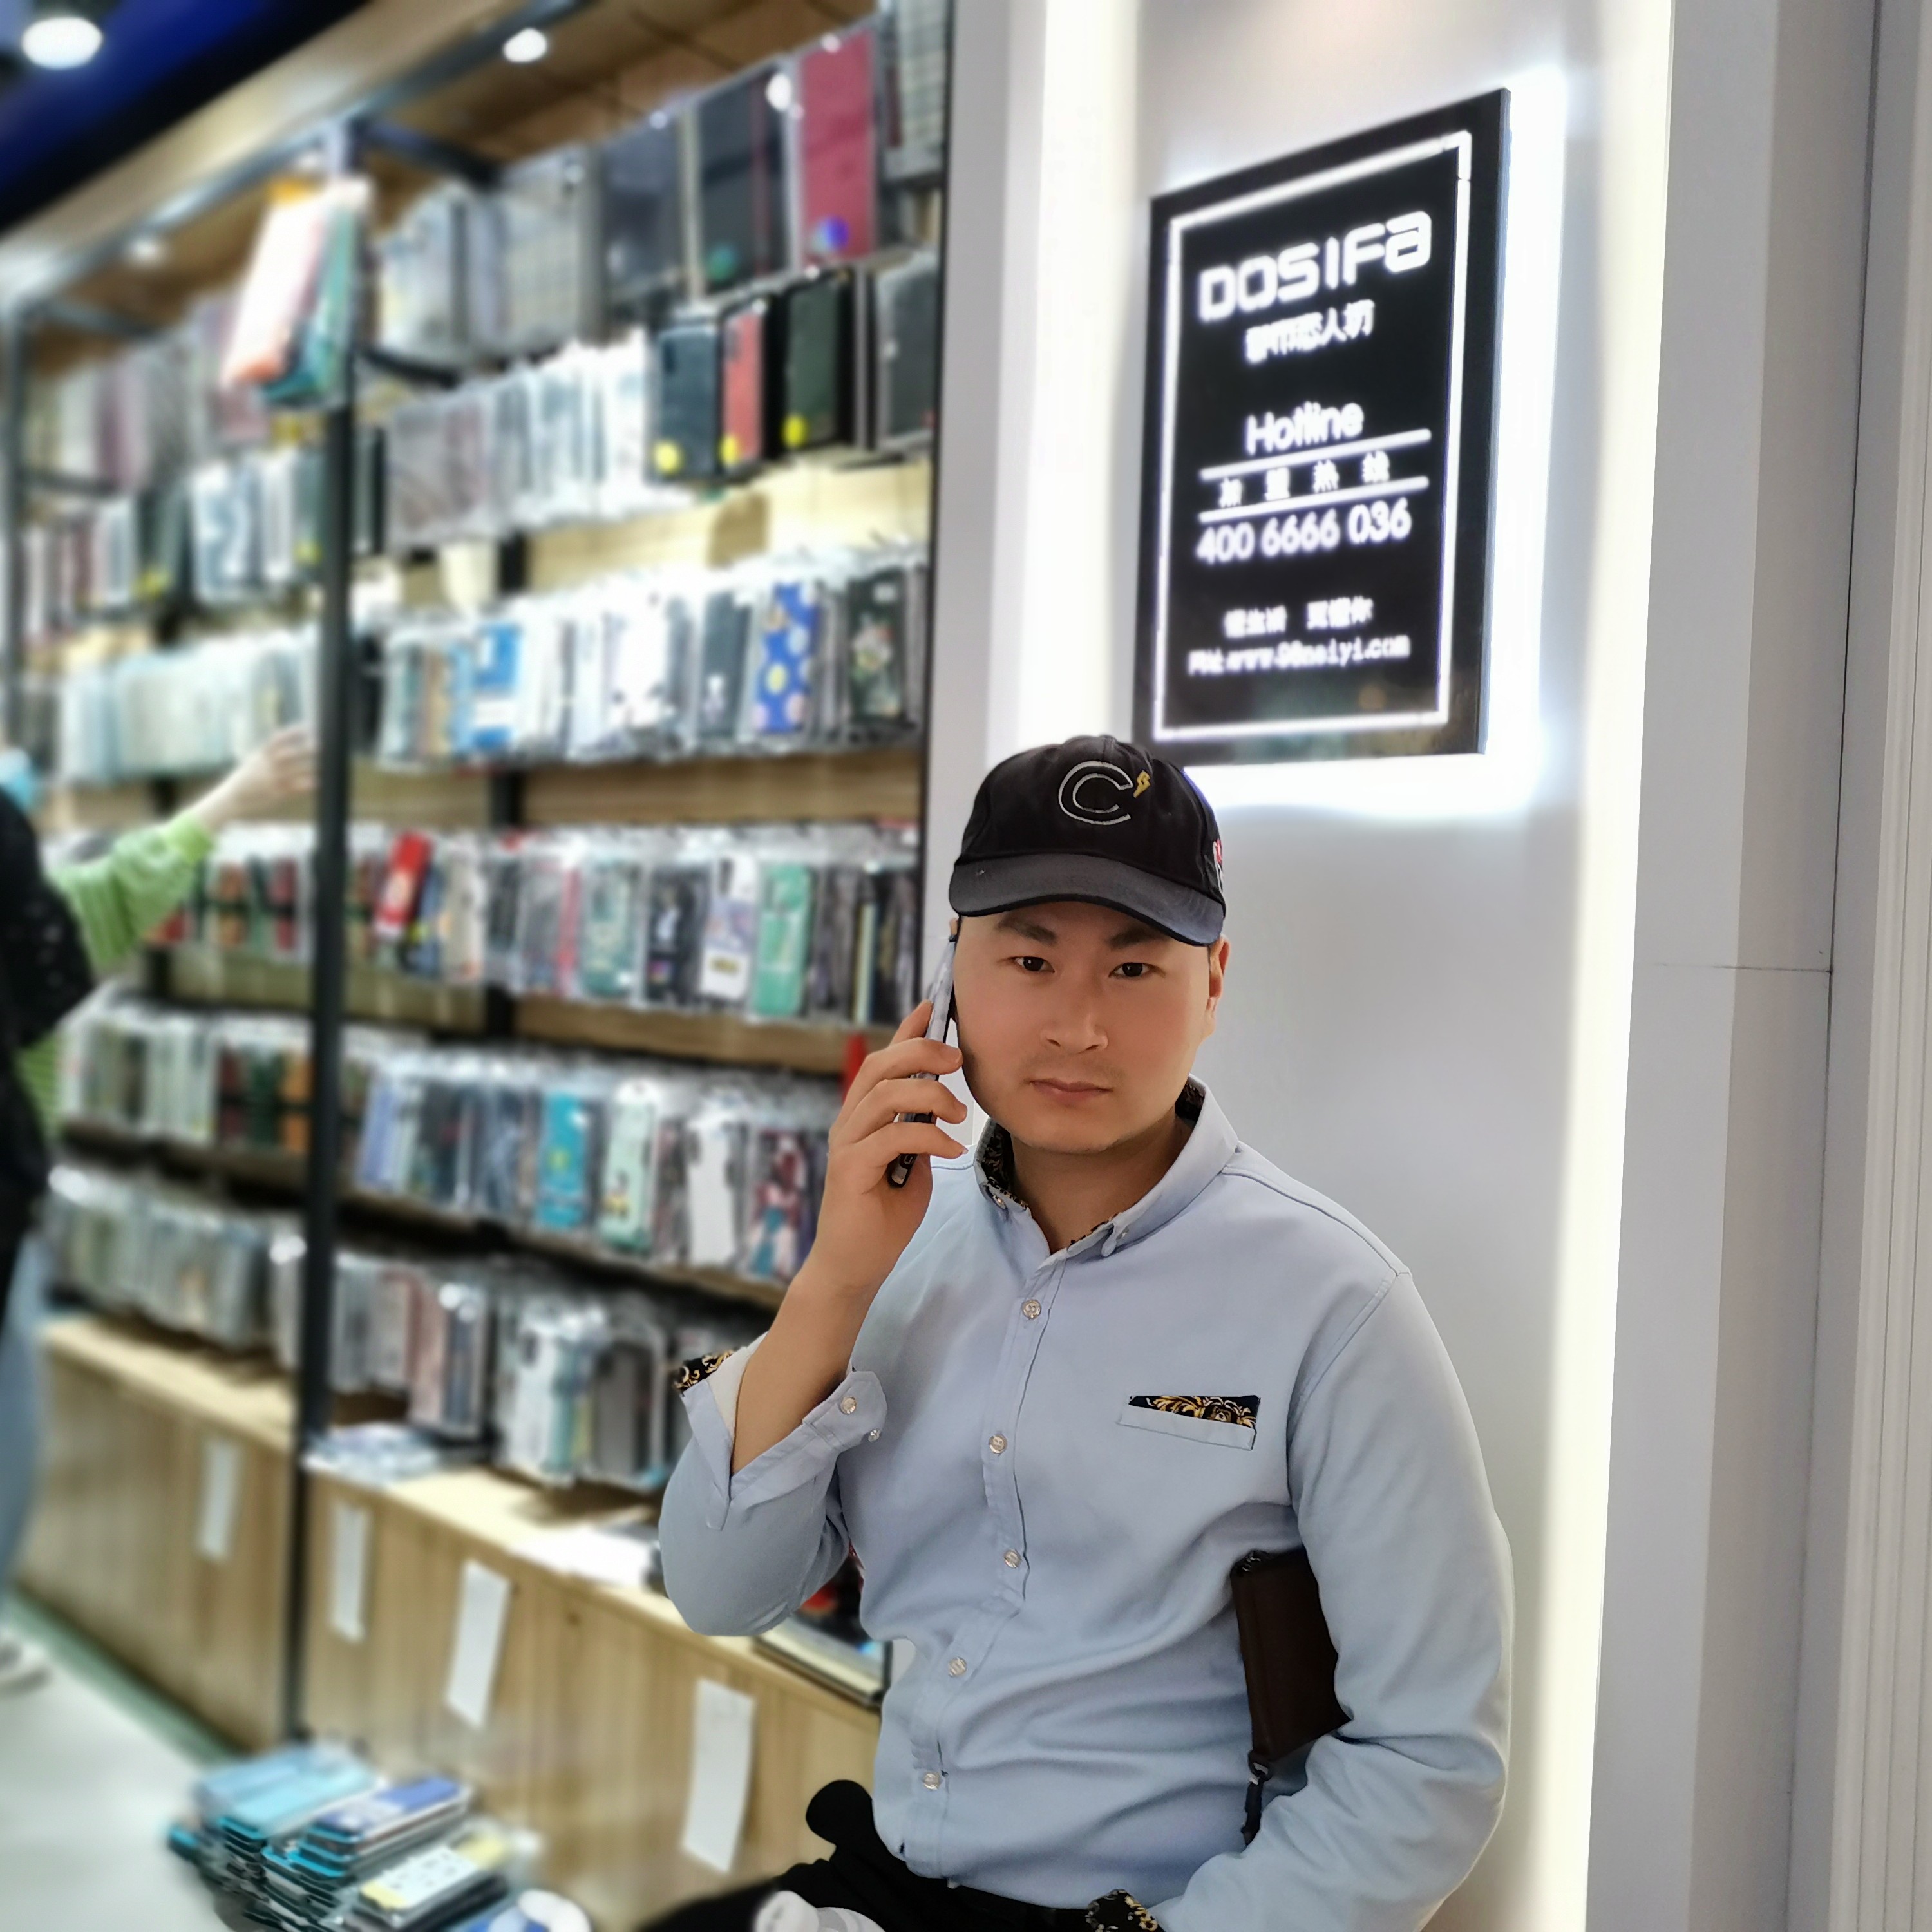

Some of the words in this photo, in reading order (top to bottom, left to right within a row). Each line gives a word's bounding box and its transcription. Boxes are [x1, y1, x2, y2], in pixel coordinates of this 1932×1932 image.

[1245, 401, 1364, 455] Hotline
[1196, 522, 1256, 564] 400
[1260, 508, 1341, 557] 6666
[1347, 497, 1412, 544] 036
[1058, 760, 1134, 826] C
